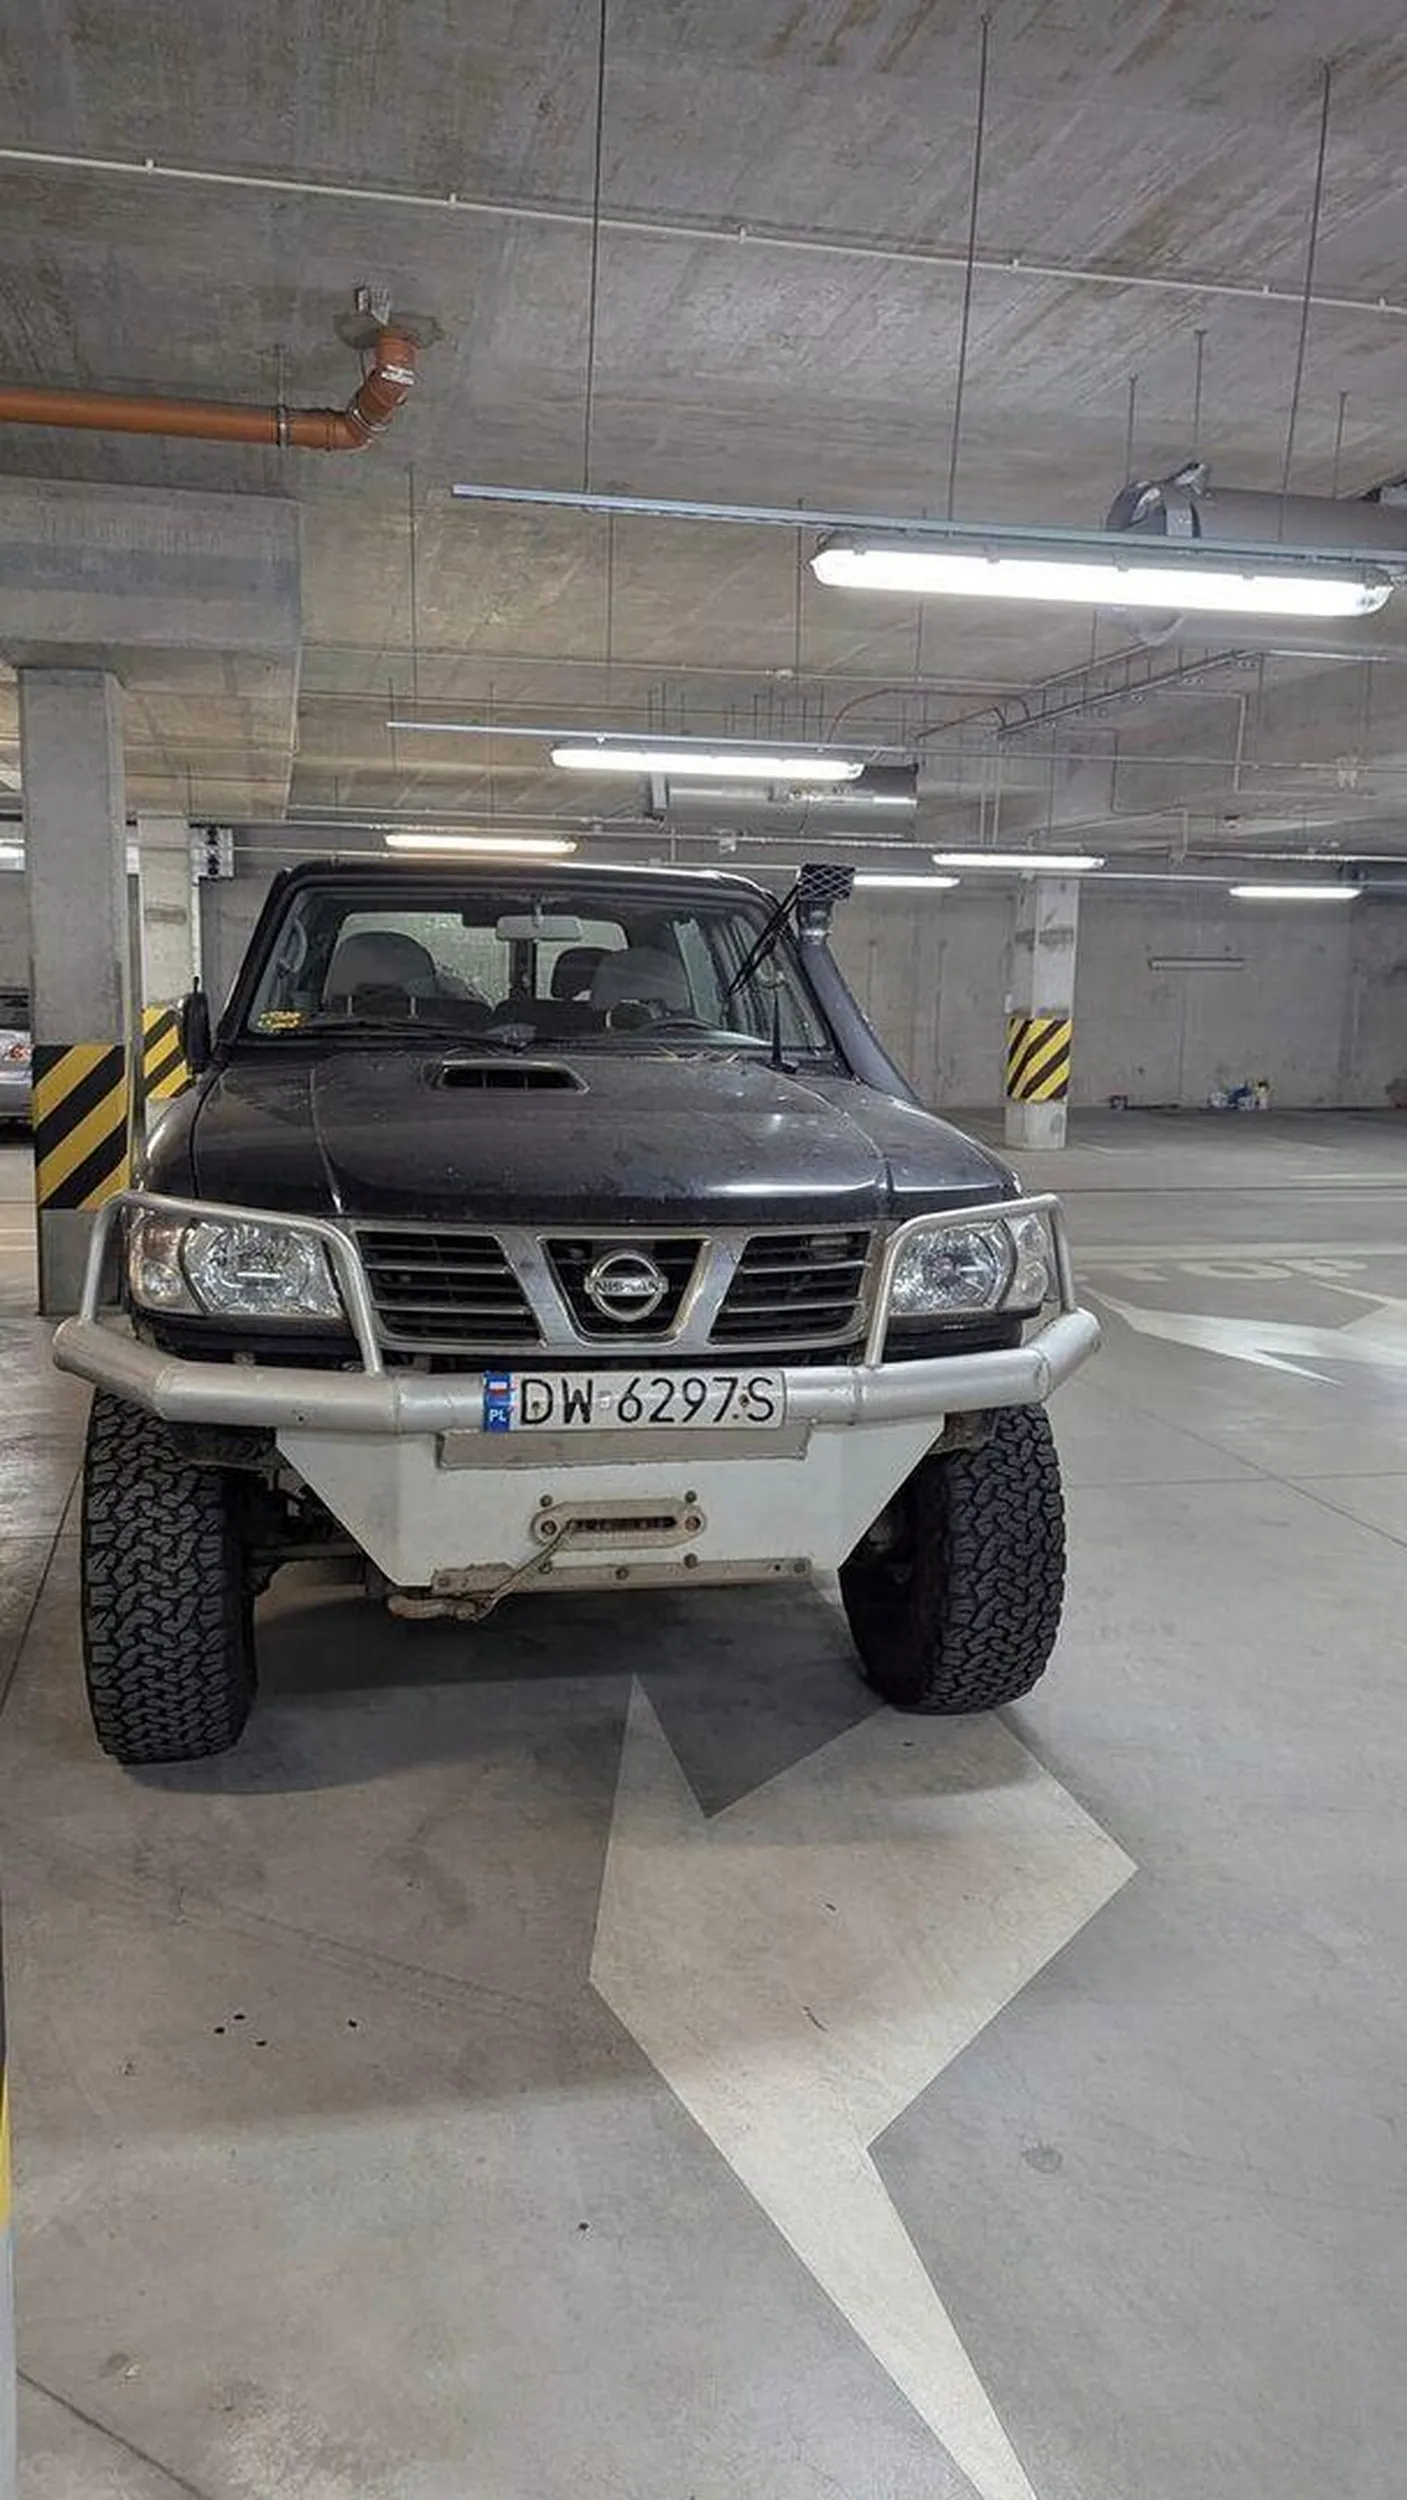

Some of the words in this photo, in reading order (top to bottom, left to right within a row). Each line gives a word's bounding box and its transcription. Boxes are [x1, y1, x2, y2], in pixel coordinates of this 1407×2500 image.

[1074, 1258, 1367, 1282] TOP
[520, 1377, 593, 1425] DW
[617, 1376, 775, 1424] 6297S
[489, 1408, 508, 1423] PL
